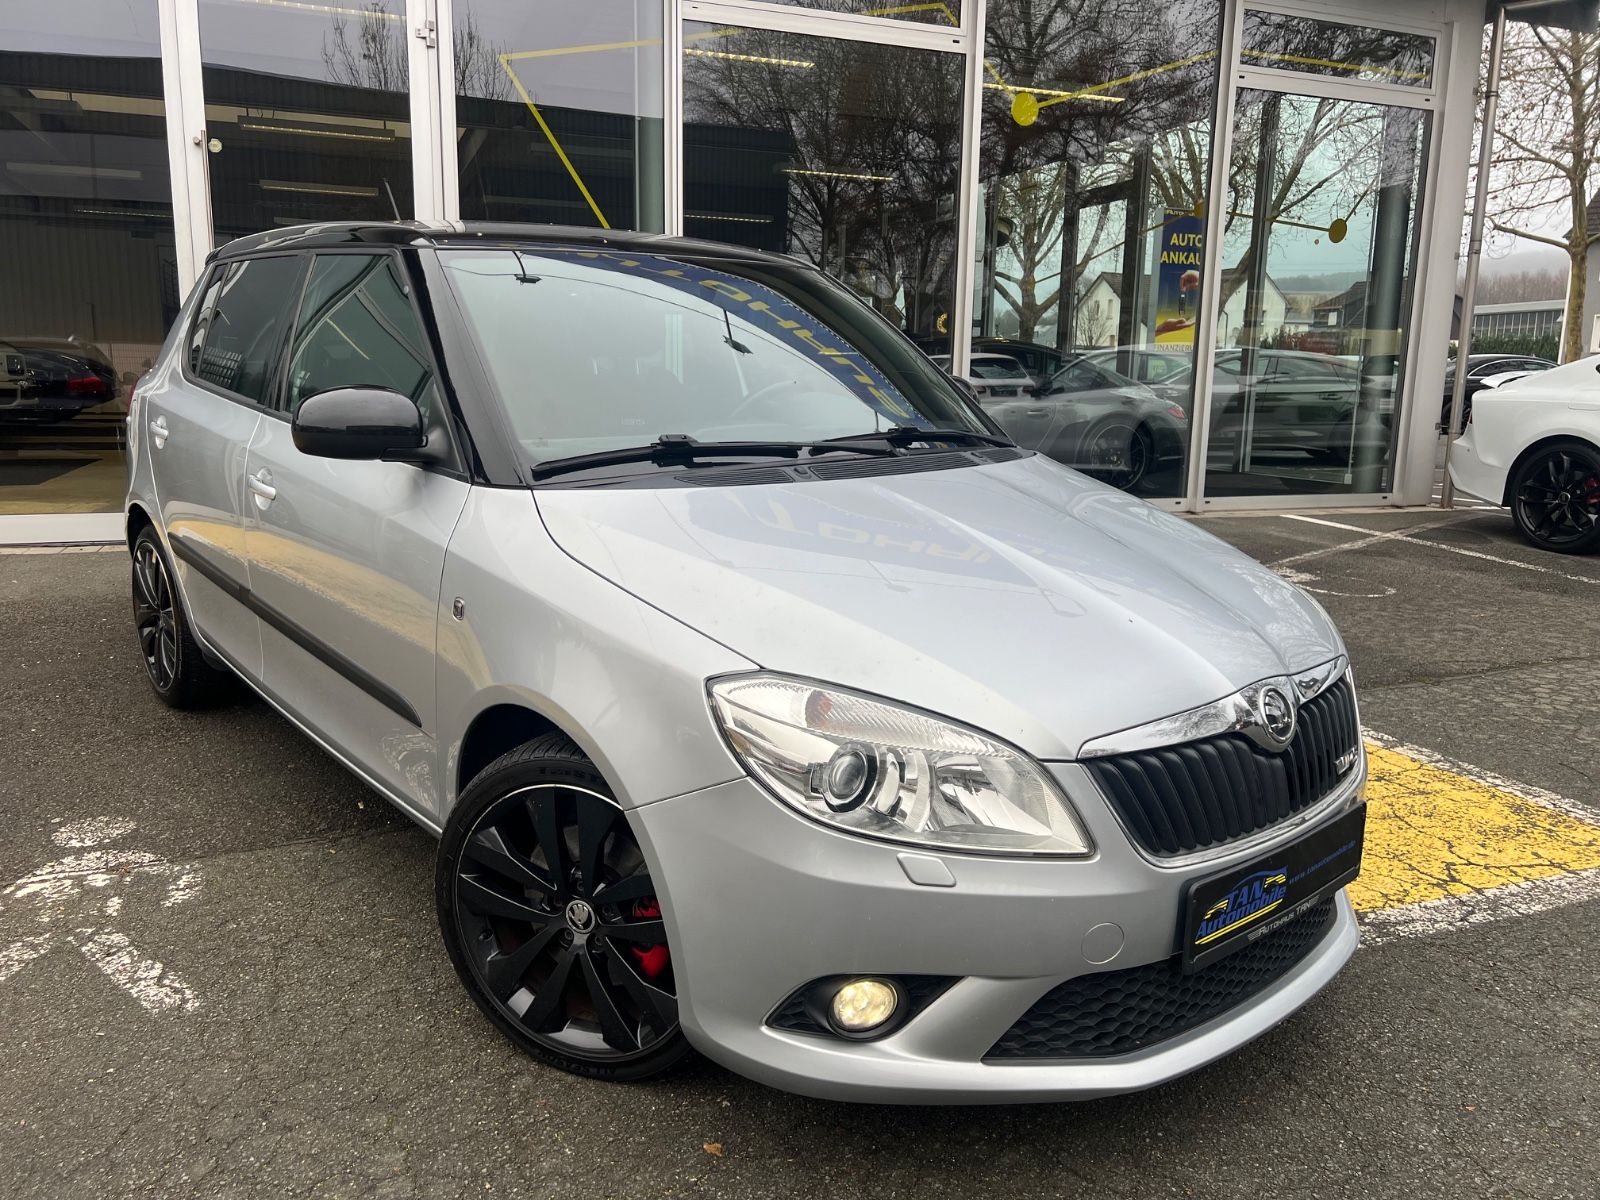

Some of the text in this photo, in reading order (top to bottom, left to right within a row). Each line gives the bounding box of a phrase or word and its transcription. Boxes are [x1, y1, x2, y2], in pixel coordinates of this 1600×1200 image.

[1160, 250, 1200, 265] ANKAU
[1153, 343, 1192, 353] FINANZIERU
[1226, 878, 1266, 912] TAN
[1196, 886, 1286, 939] Automobile
